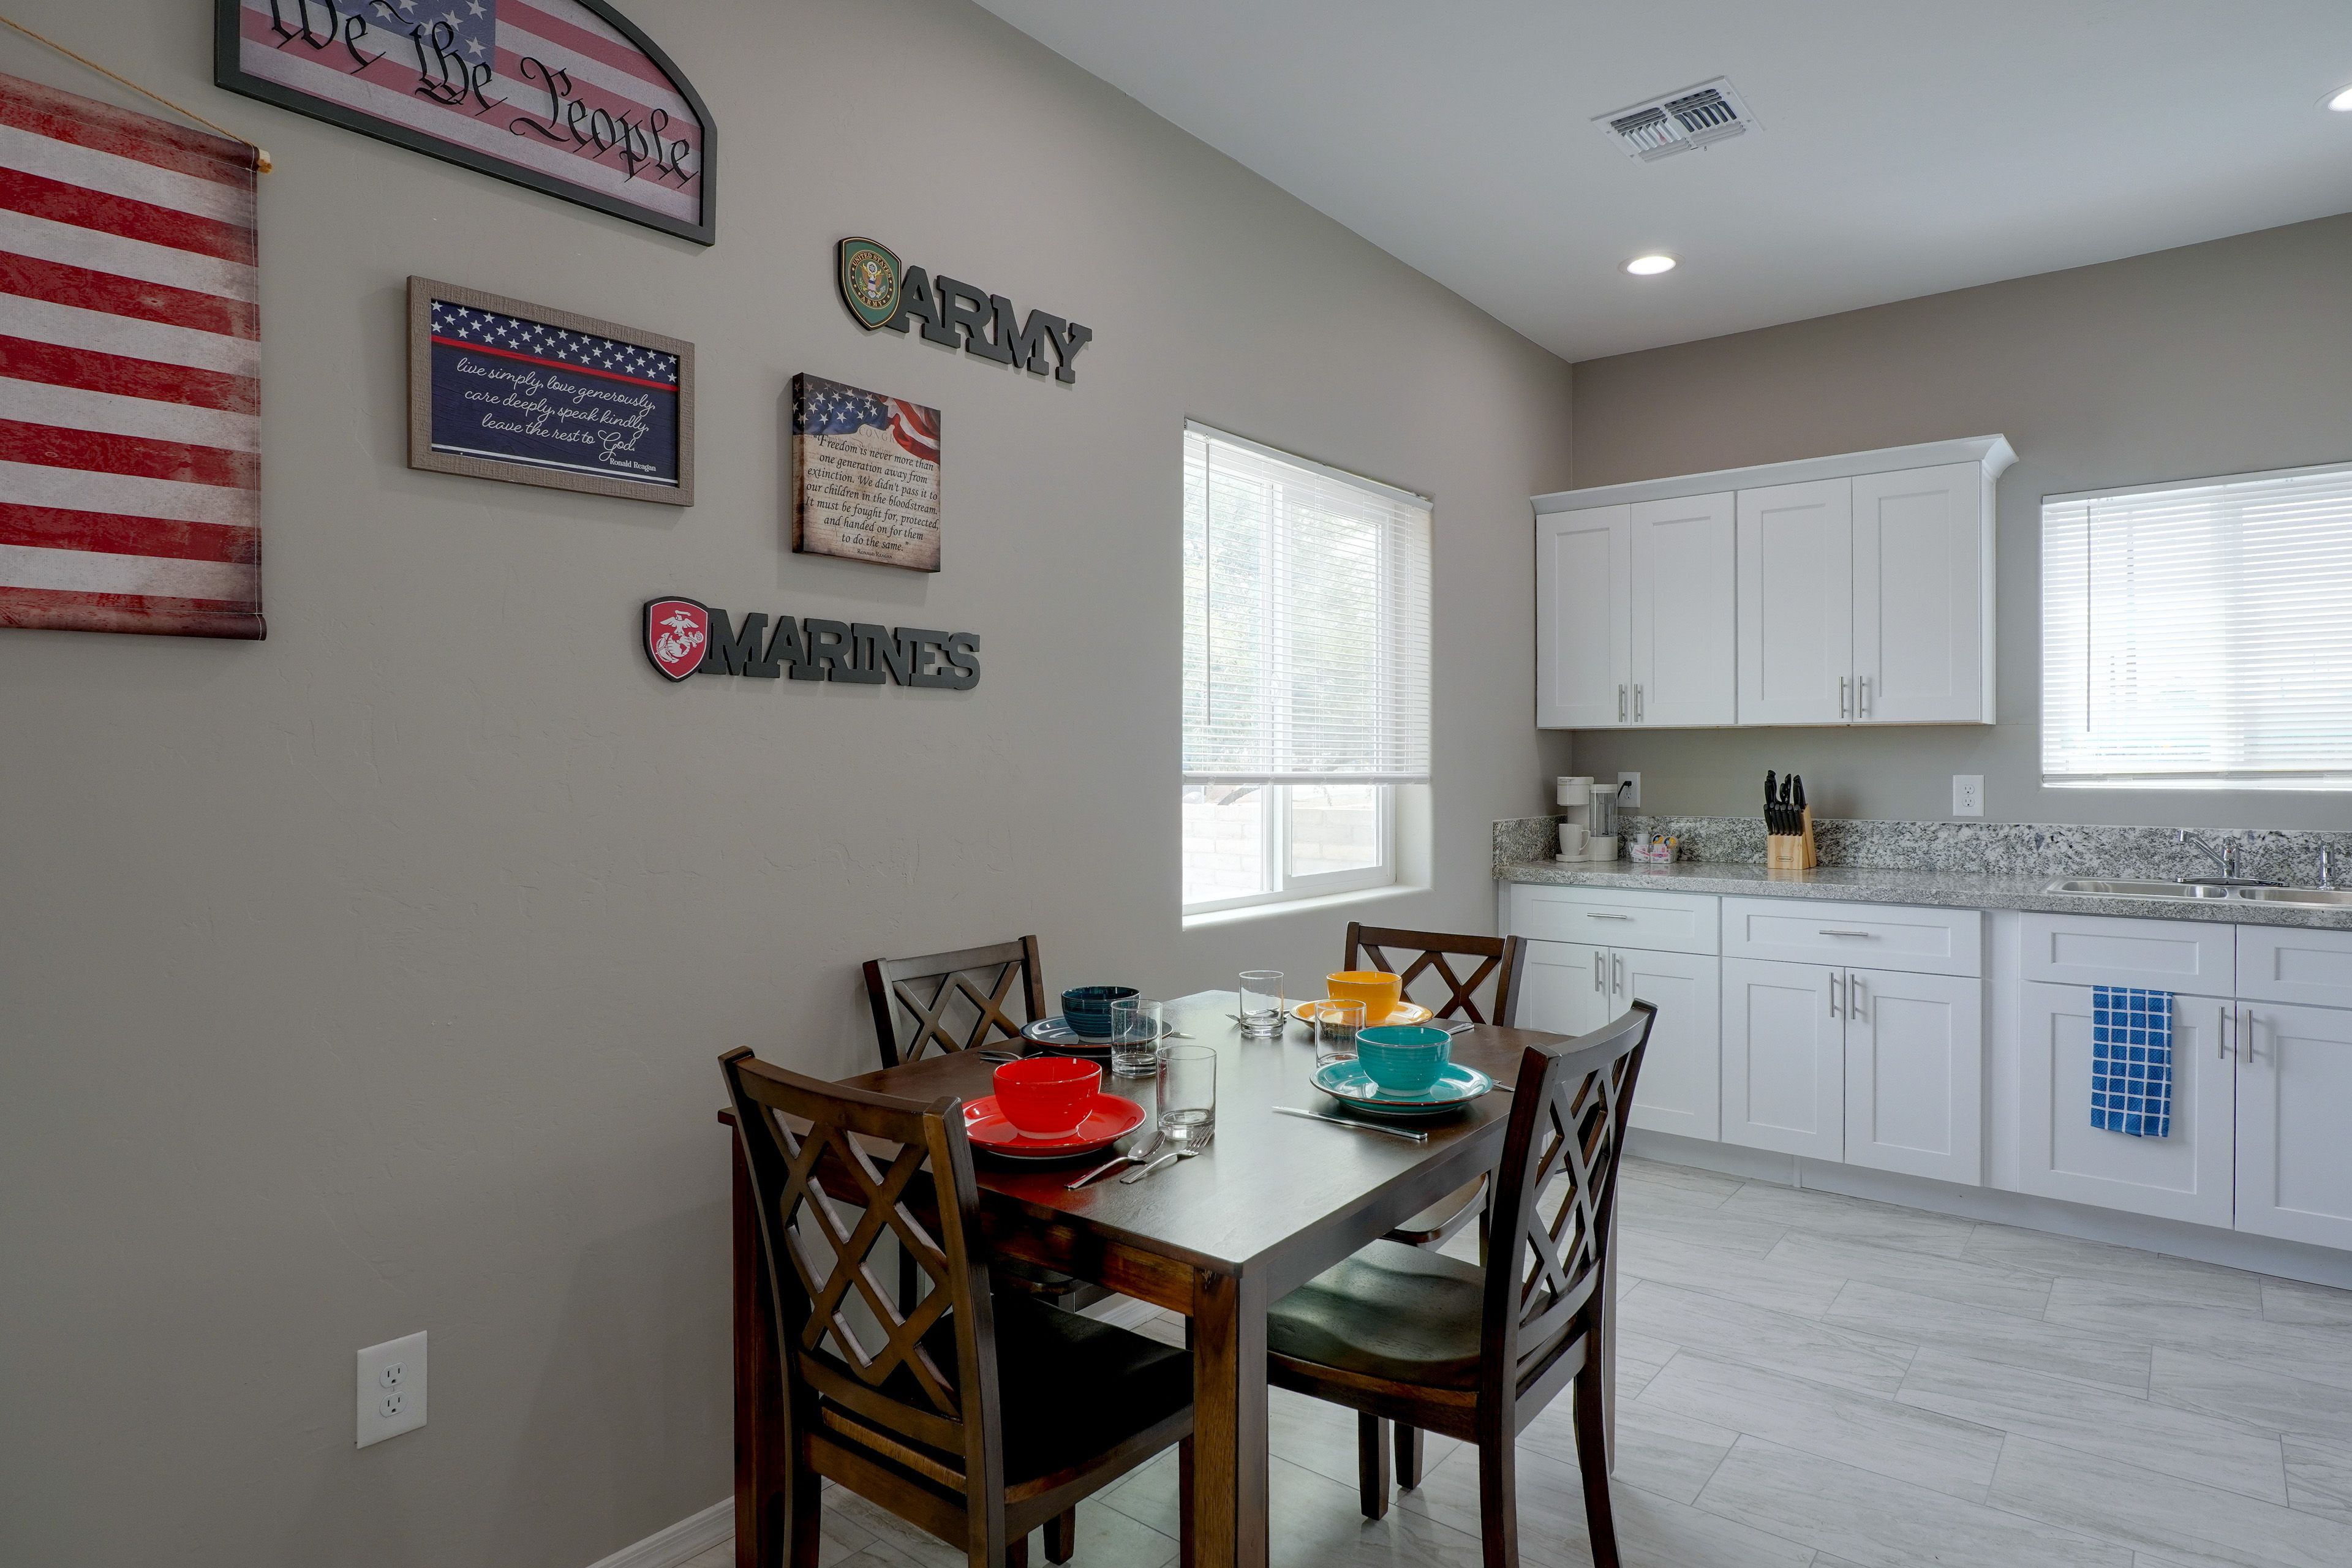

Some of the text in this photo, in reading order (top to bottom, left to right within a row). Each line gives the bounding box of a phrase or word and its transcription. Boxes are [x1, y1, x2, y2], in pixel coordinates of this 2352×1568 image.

[271, 0, 386, 74] We
[510, 57, 699, 189] People
[852, 252, 892, 279] UNITED STATES
[861, 296, 882, 306] ARMY
[883, 265, 1092, 383] ARMY
[457, 357, 655, 417] live simply, love generously,
[465, 391, 649, 439] care deeply, speak kindly,
[482, 413, 635, 461] leave the rest to God.
[609, 458, 657, 472] Ronald Reagan
[820, 454, 927, 484] one generation away from
[870, 450, 892, 461] never
[894, 456, 913, 466] more
[915, 458, 933, 470] than
[806, 483, 937, 514] our children in the bloodstream.
[807, 467, 937, 500] extinction. We didn't pass it to
[805, 496, 939, 531] It must be fought for, protected,
[824, 516, 843, 526] and
[843, 516, 876, 532] handed
[887, 525, 902, 538] for
[904, 528, 923, 540] them
[842, 533, 850, 543] to
[853, 533, 864, 545] do
[866, 536, 879, 547] the
[699, 608, 981, 690] MARINES
